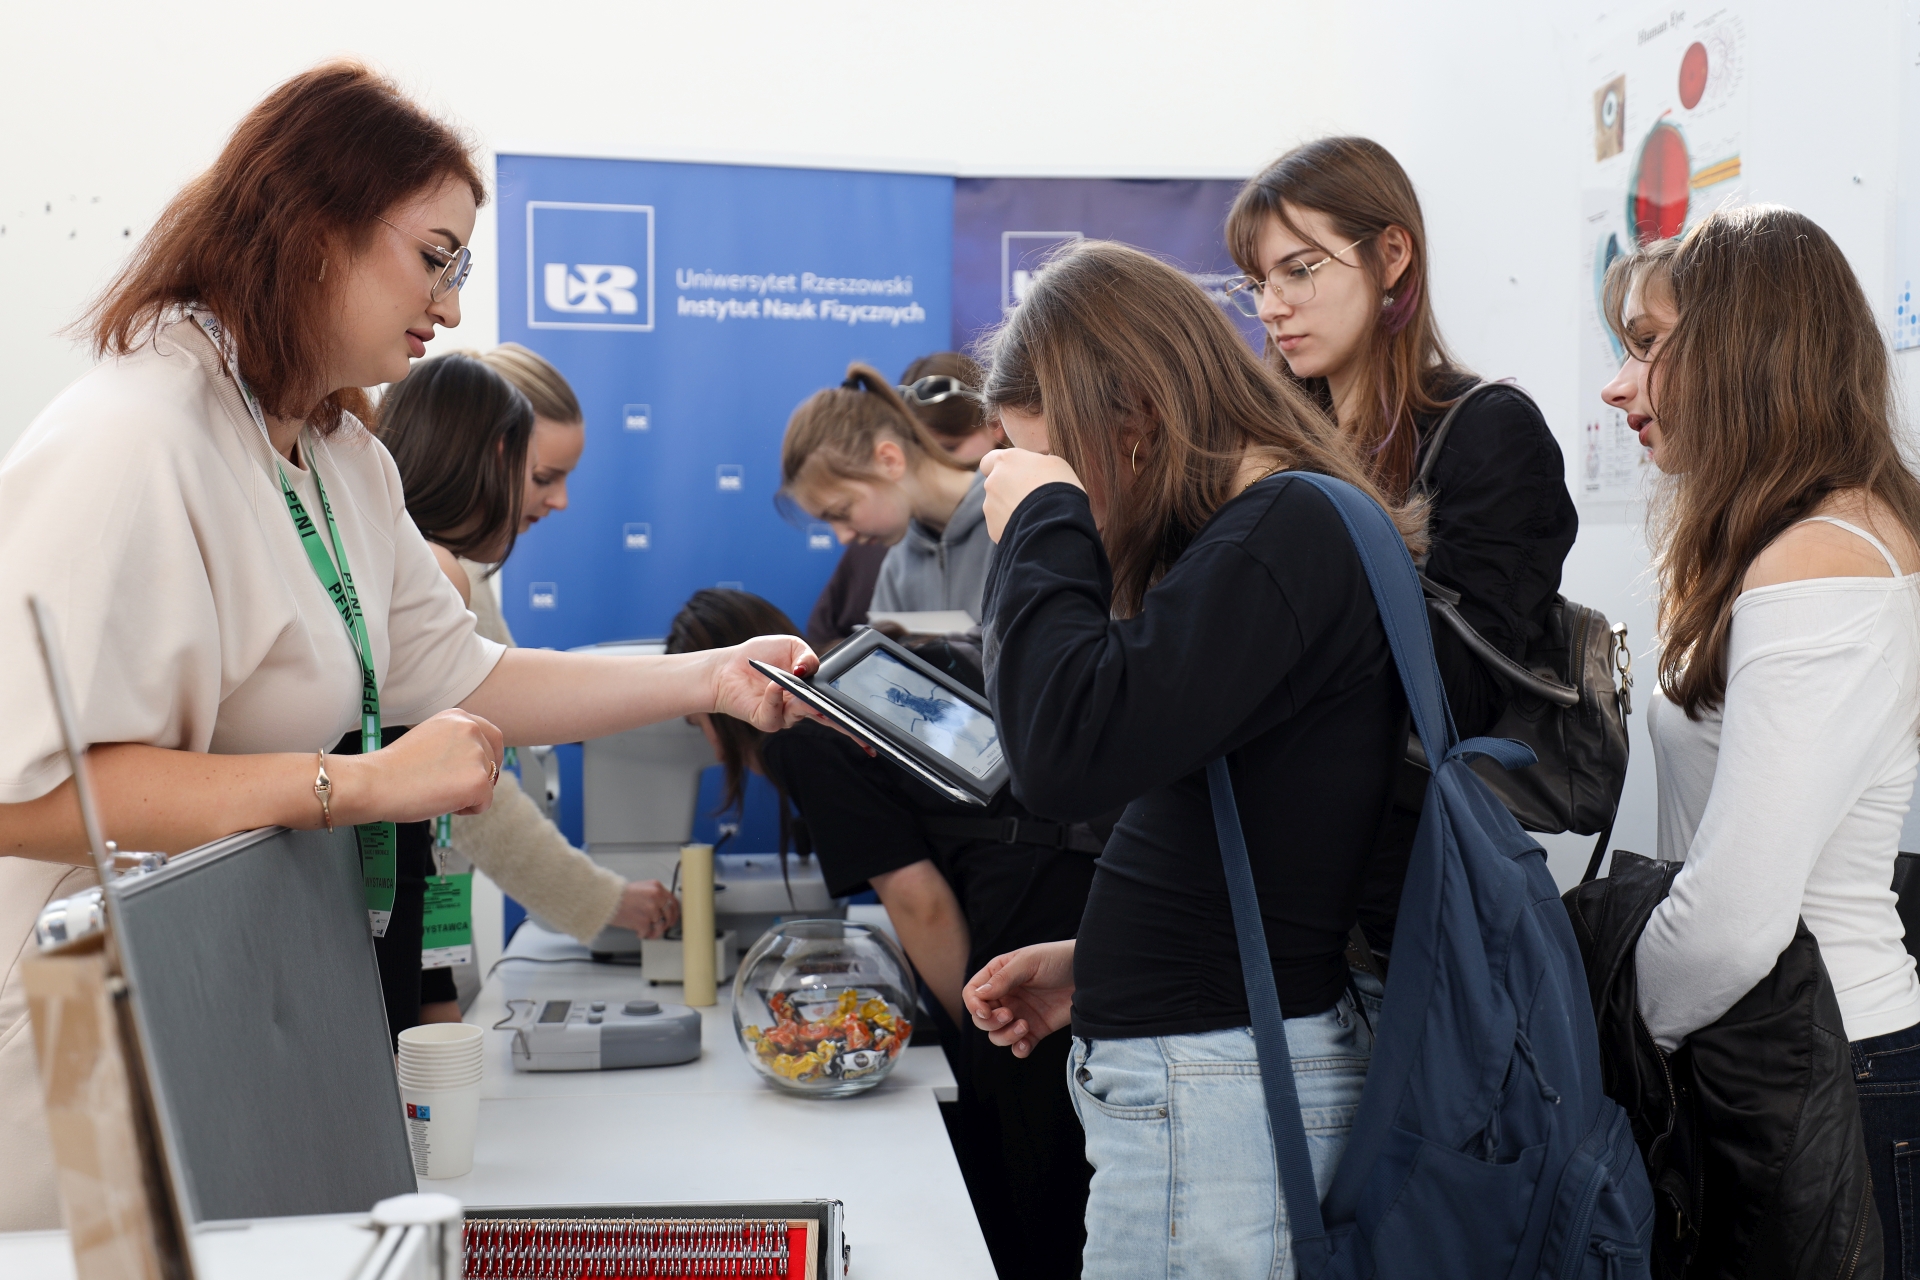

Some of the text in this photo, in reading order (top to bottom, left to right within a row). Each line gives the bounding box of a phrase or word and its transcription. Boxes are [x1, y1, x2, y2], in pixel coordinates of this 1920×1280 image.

[1637, 20, 1669, 46] Human
[1670, 10, 1686, 29] Eye
[676, 268, 914, 297] Uniwersytet Rzeszowski
[677, 295, 926, 327] Instytut Nauk Fizycznych
[284, 490, 317, 539] PFNI
[328, 581, 355, 629] PFNI
[343, 572, 363, 617] PFNI
[365, 877, 394, 889] WYSTAWCA
